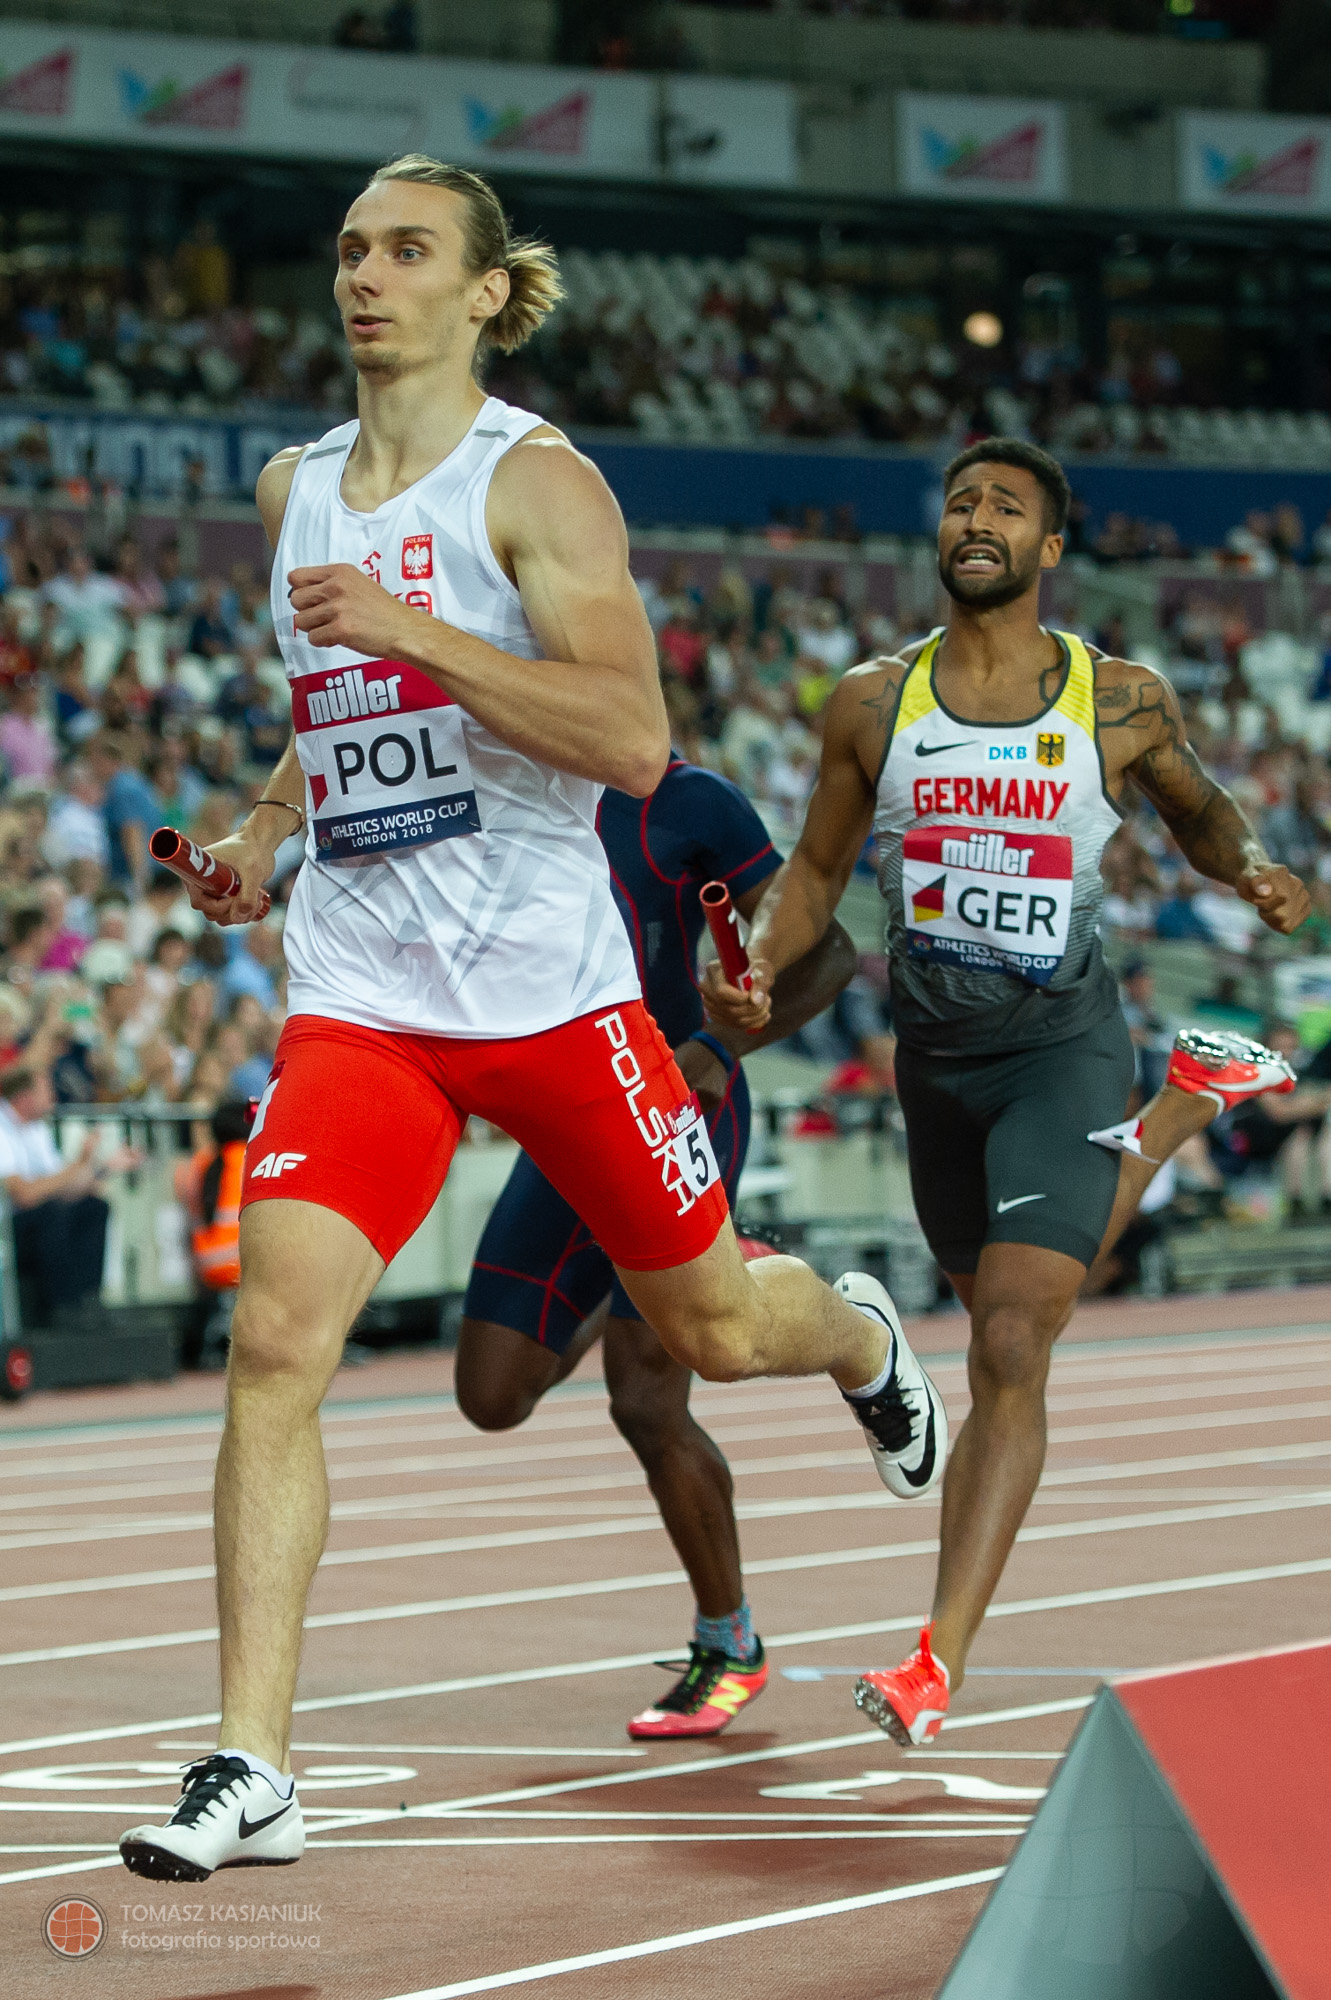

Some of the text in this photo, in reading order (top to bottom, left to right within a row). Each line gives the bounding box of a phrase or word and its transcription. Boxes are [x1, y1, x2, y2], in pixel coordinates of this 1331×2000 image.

[404, 535, 432, 545] POLSKA
[307, 669, 401, 726] müller
[333, 727, 458, 796] POL
[988, 745, 1028, 761] DKB
[912, 777, 1070, 821] GERMANY
[331, 801, 468, 840] ATHLETICS WORLD CUP
[352, 823, 433, 848] LONDON 2018
[941, 833, 1035, 877] müller
[957, 886, 1059, 938] GER
[932, 937, 1058, 970] ATHLETICS WORLD CUP
[959, 954, 1003, 968] LONDON
[251, 1152, 307, 1179] 4F
[686, 1127, 709, 1187] 5
